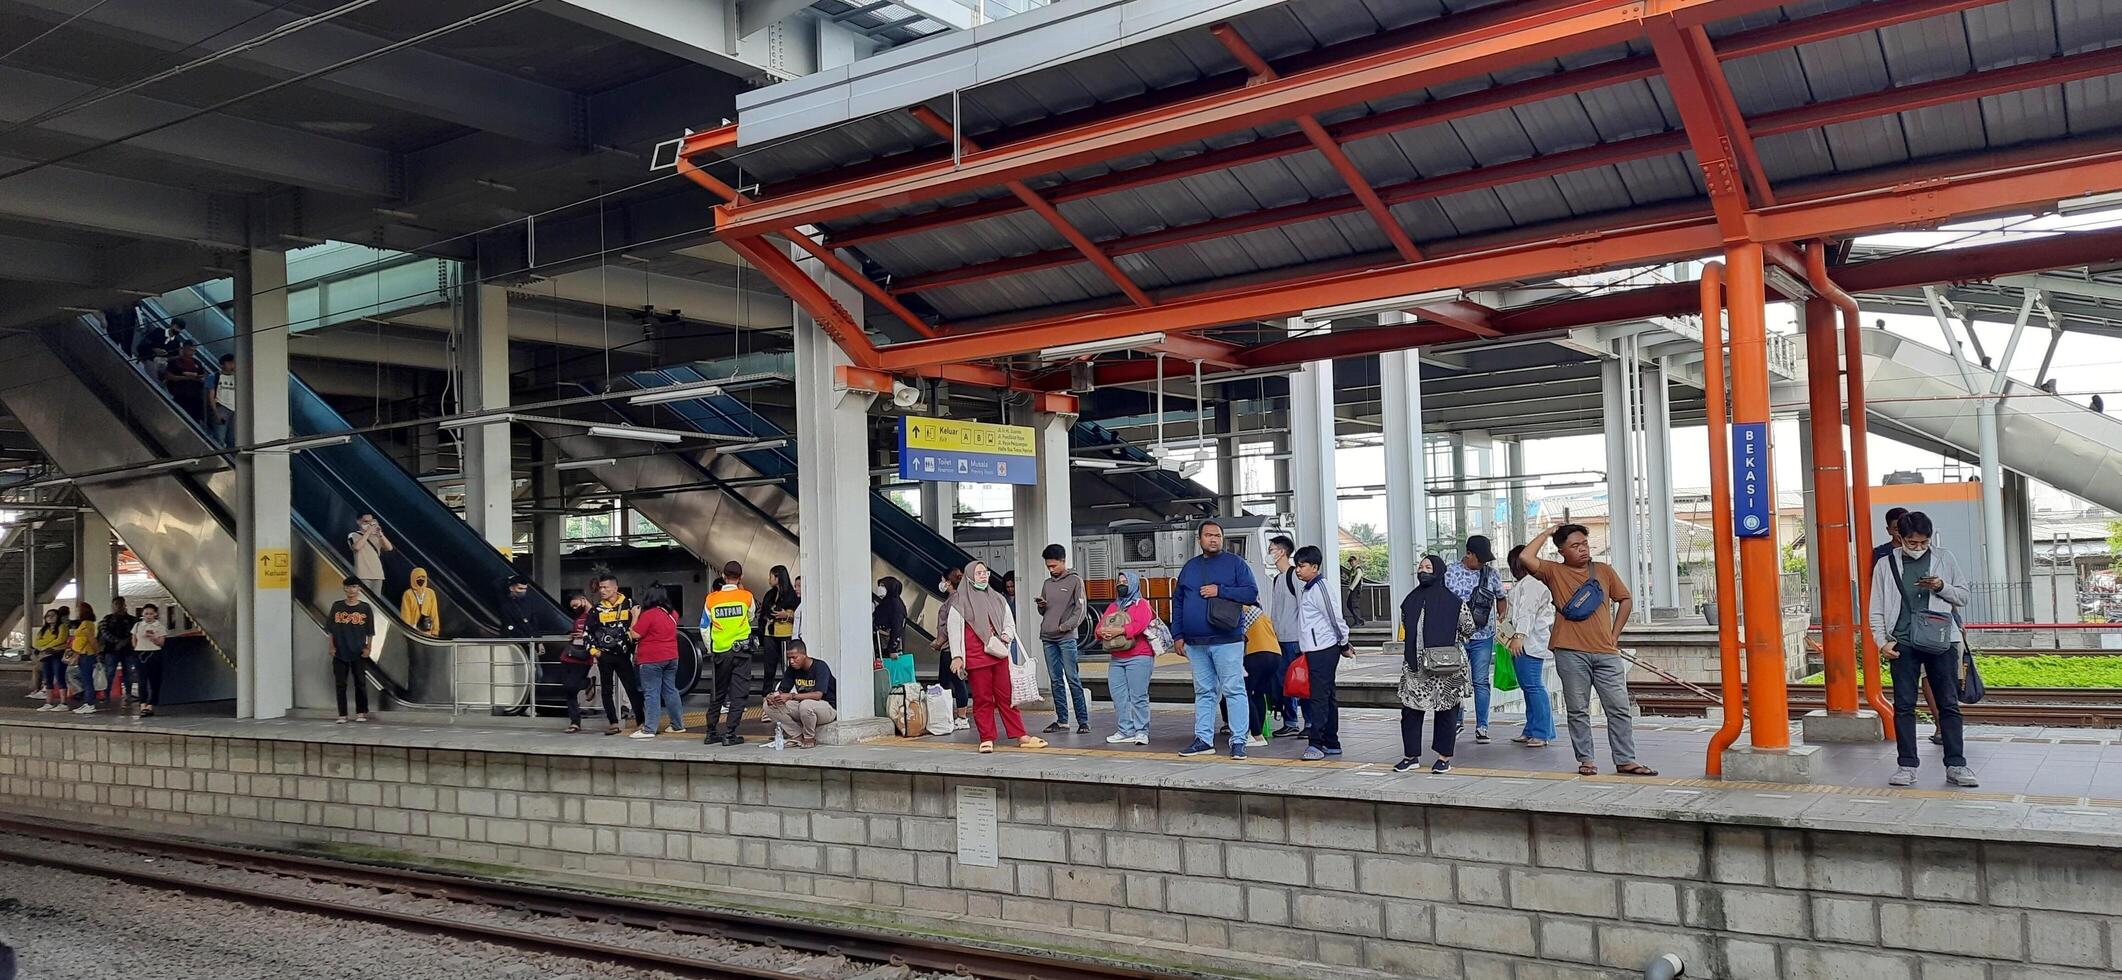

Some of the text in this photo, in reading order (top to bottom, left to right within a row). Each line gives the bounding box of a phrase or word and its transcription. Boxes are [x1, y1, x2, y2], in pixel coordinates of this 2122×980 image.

[939, 426, 982, 442] Keluar A B
[937, 457, 952, 466] Toilet
[1745, 430, 1756, 508] BEKASI
[715, 606, 742, 616] SATPAM
